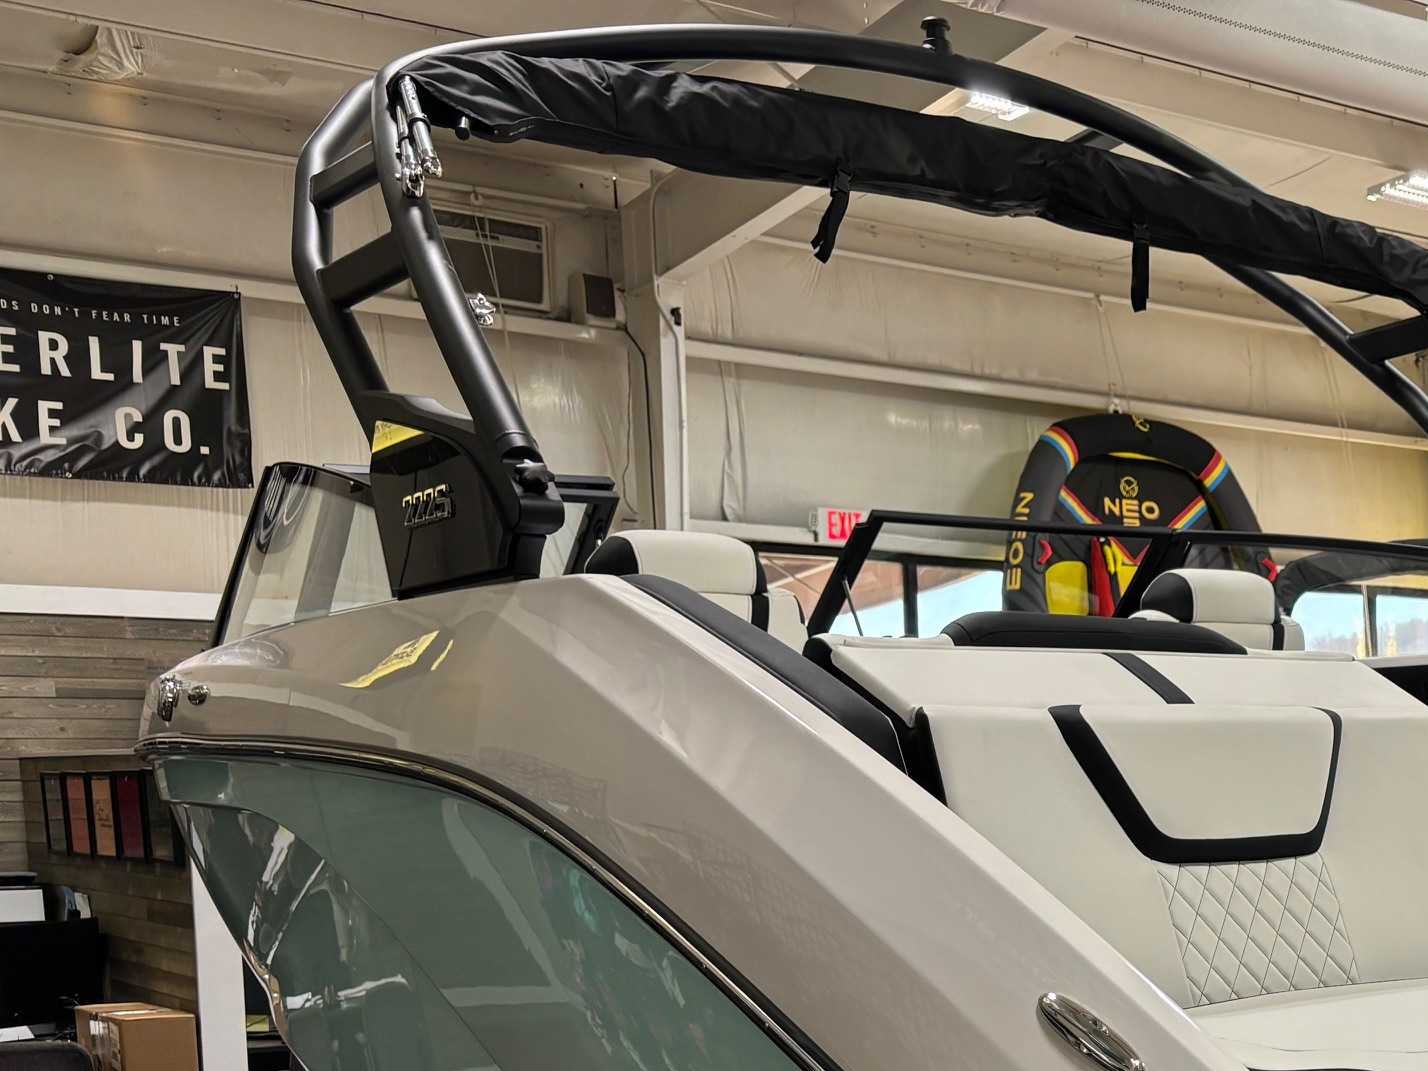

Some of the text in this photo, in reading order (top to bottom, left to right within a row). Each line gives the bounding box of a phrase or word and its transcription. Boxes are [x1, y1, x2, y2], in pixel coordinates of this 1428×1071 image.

[31, 302, 80, 318] DON'T
[91, 309, 132, 323] FEAR
[142, 313, 182, 327] TIME
[0, 326, 230, 391] ERLITE
[114, 406, 210, 455] CO.
[1103, 496, 1161, 521] NEO
